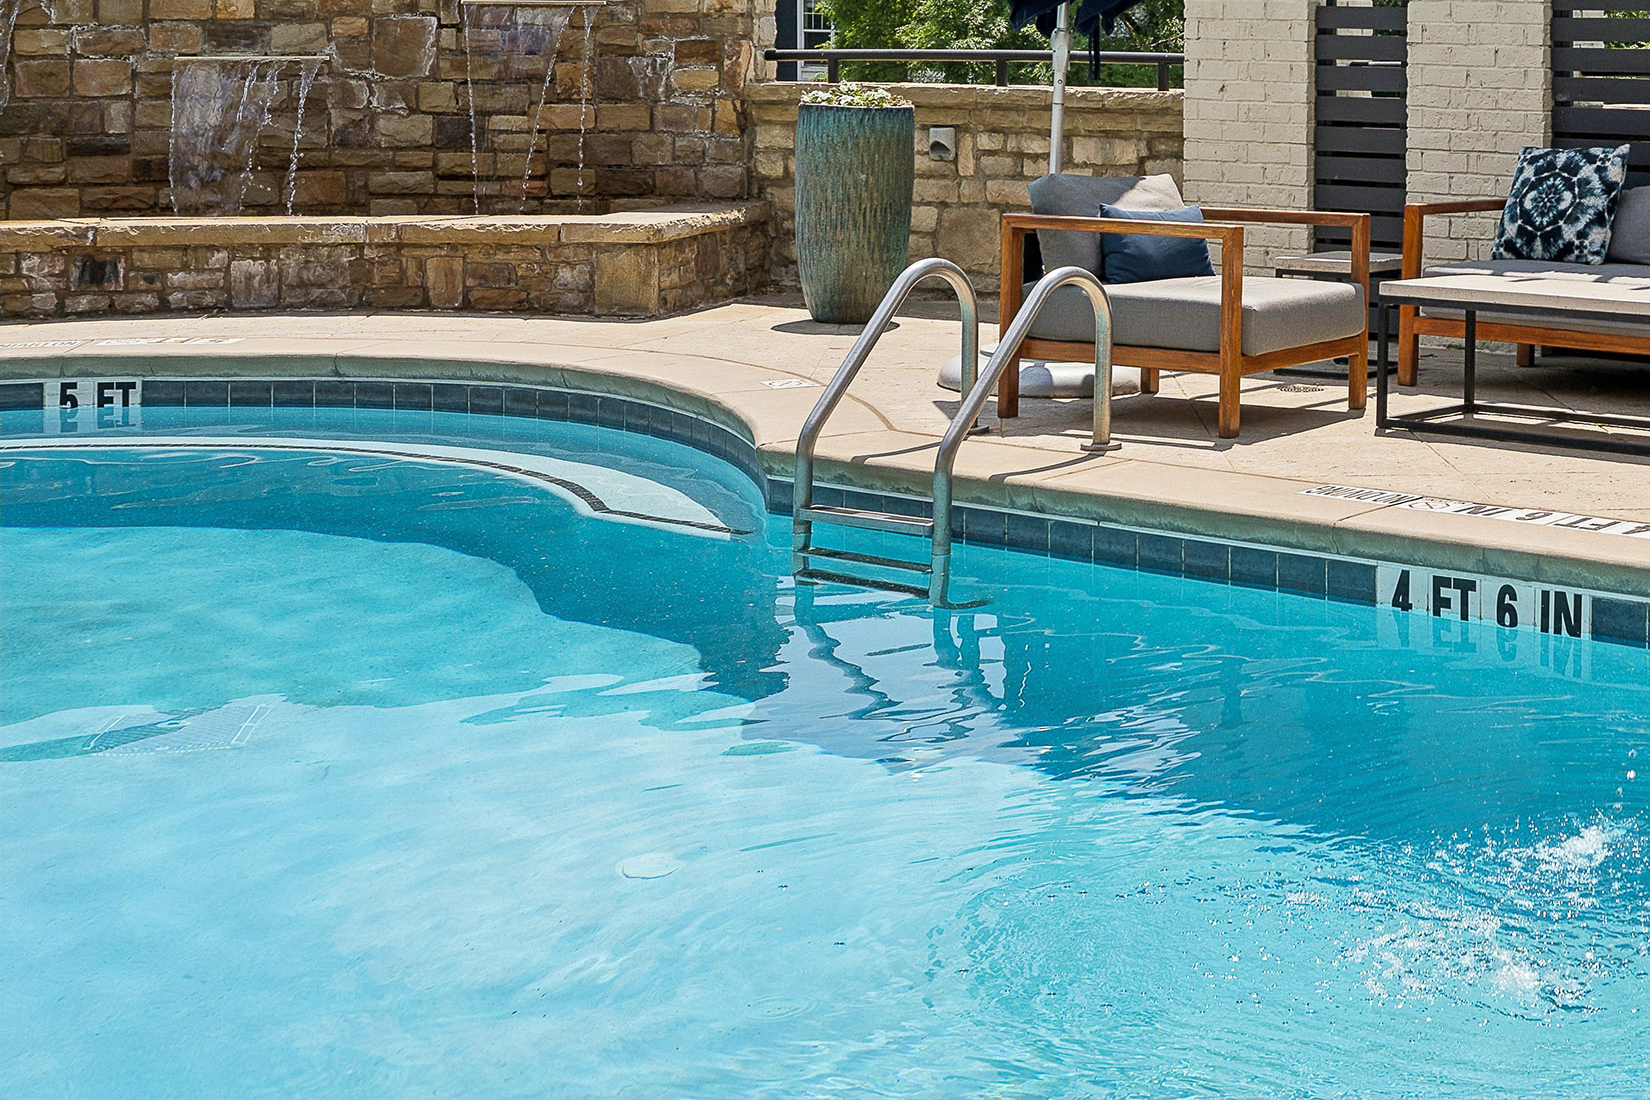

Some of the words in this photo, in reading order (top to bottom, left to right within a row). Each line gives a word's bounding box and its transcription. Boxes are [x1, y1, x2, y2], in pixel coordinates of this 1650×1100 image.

[59, 381, 79, 409] 5
[97, 381, 137, 408] FT
[1453, 505, 1512, 517] IN
[1515, 511, 1552, 521] 6
[1554, 517, 1621, 531] FT
[1392, 569, 1412, 612] 4
[1432, 575, 1477, 622] FT
[1496, 584, 1518, 628] 6
[1540, 590, 1582, 638] IN
